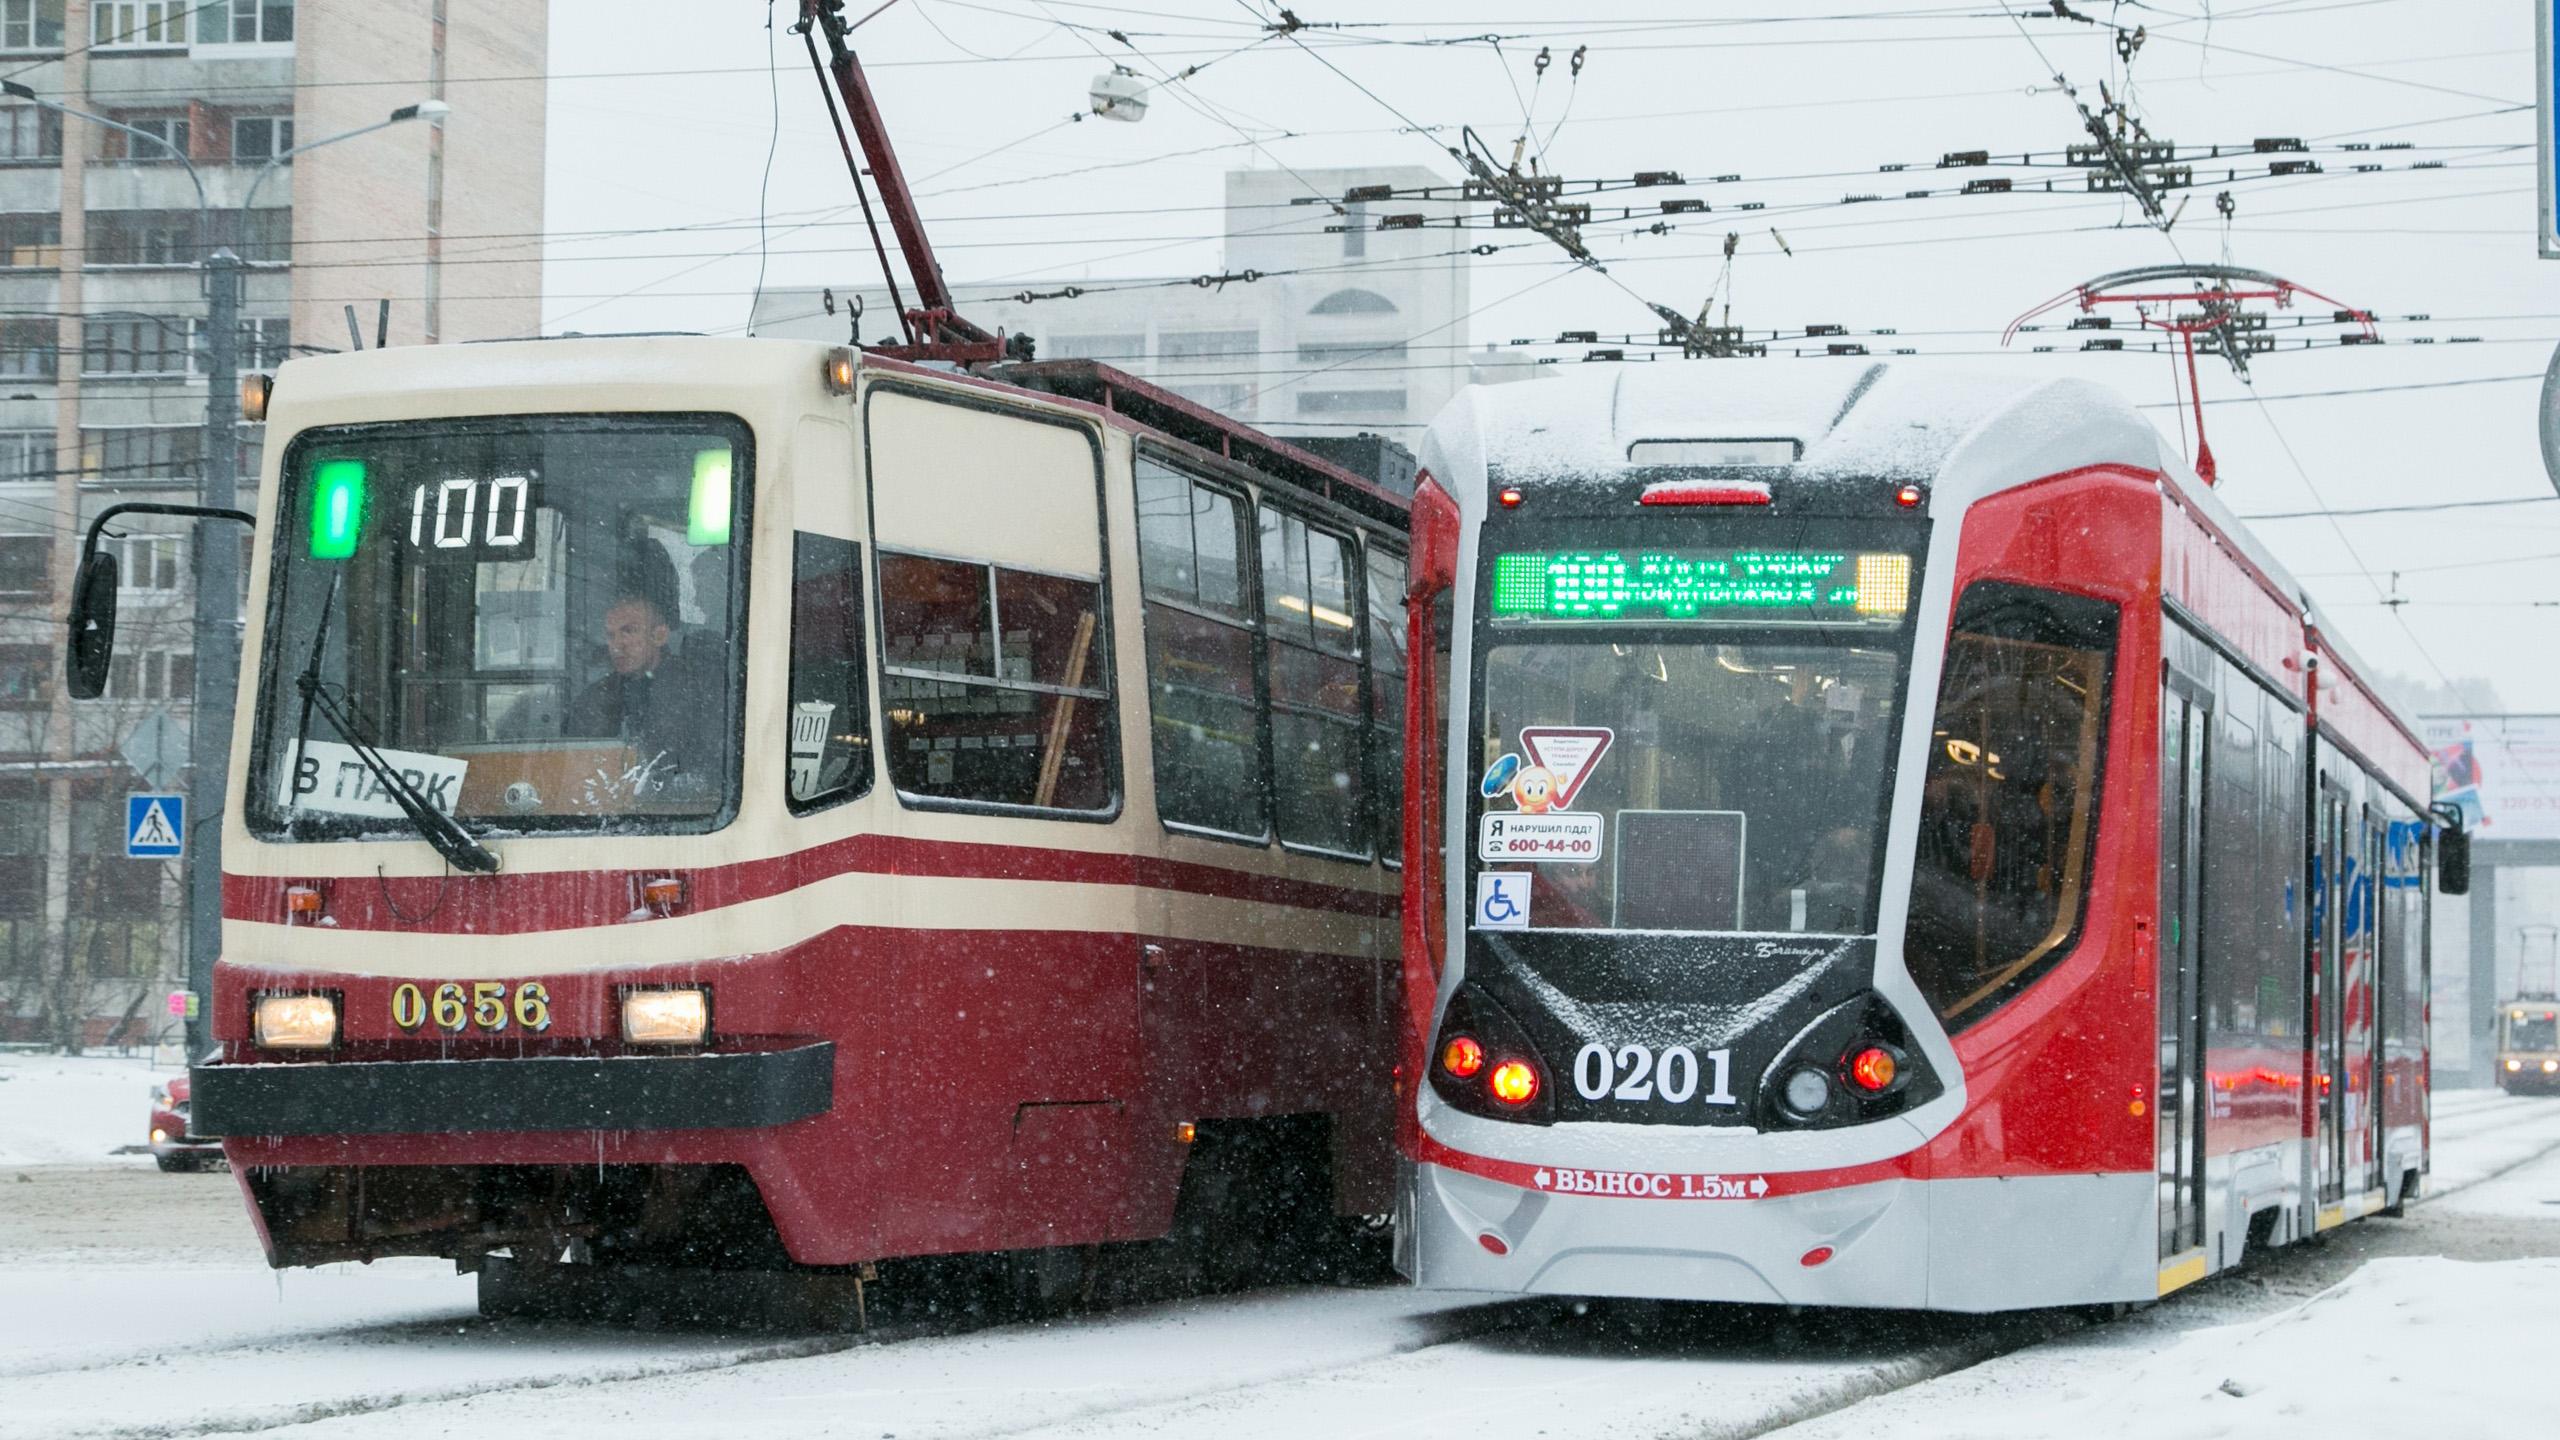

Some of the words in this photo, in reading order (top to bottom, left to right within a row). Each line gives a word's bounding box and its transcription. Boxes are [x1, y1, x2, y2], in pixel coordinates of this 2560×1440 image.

[410, 477, 528, 548] 100
[793, 716, 826, 743] 100
[297, 757, 320, 794] В
[335, 761, 456, 812] ПАРК
[1490, 820, 1504, 836] Я
[1510, 825, 1562, 833] НАРУШИЛ
[1565, 825, 1592, 835] ПДД?
[1508, 839, 1592, 852] 600-44-00
[392, 982, 550, 1031] 0656
[1573, 1043, 1736, 1105] 0201
[1554, 1168, 1671, 1196] ВЫНОС
[1681, 1174, 1746, 1198] 1.5м
